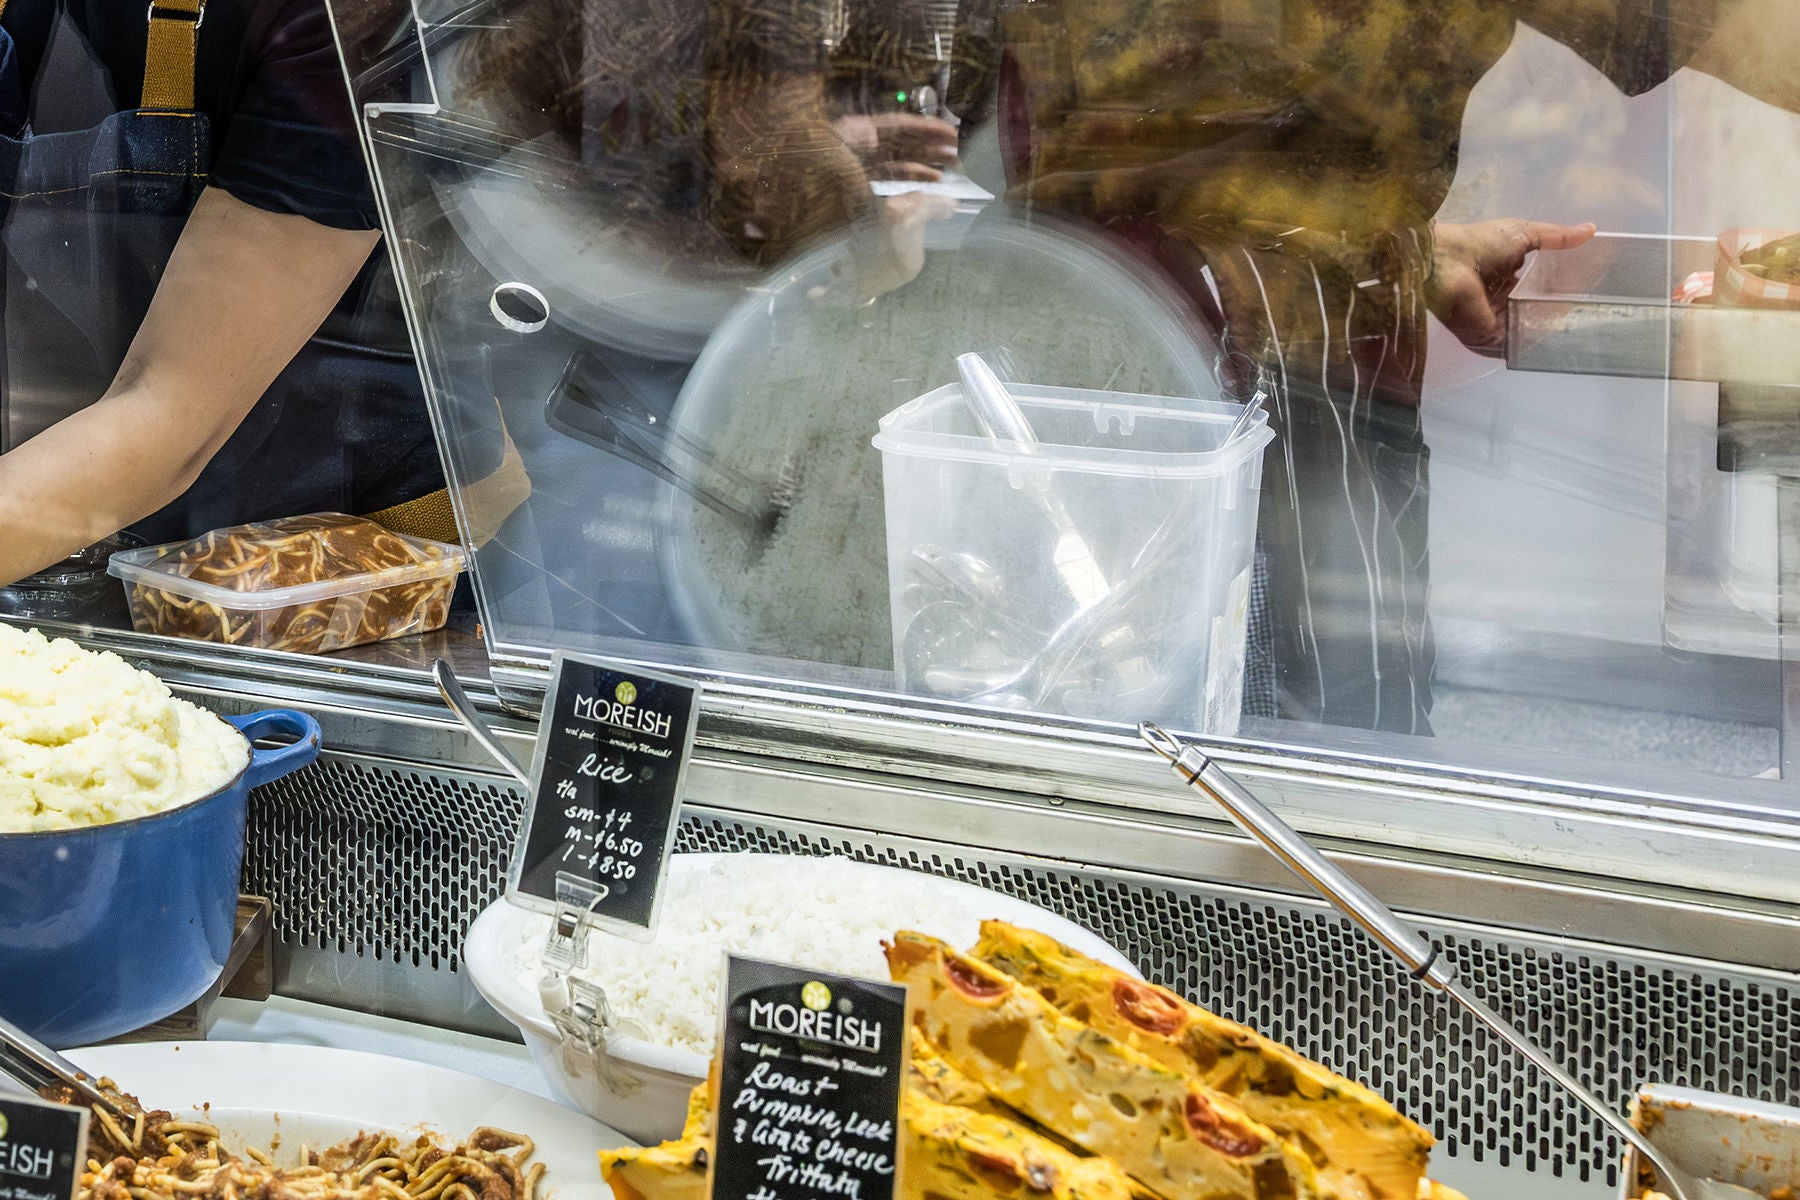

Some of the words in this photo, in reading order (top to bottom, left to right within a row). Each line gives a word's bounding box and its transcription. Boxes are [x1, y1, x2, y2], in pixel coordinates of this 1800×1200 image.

[573, 692, 673, 737] MOREISH
[576, 752, 633, 784] Rice
[750, 998, 882, 1053] MOREISH
[744, 1061, 839, 1096] Roast
[752, 1119, 812, 1154] Goats
[815, 1139, 895, 1174] Cheese
[844, 1111, 893, 1142] Leek
